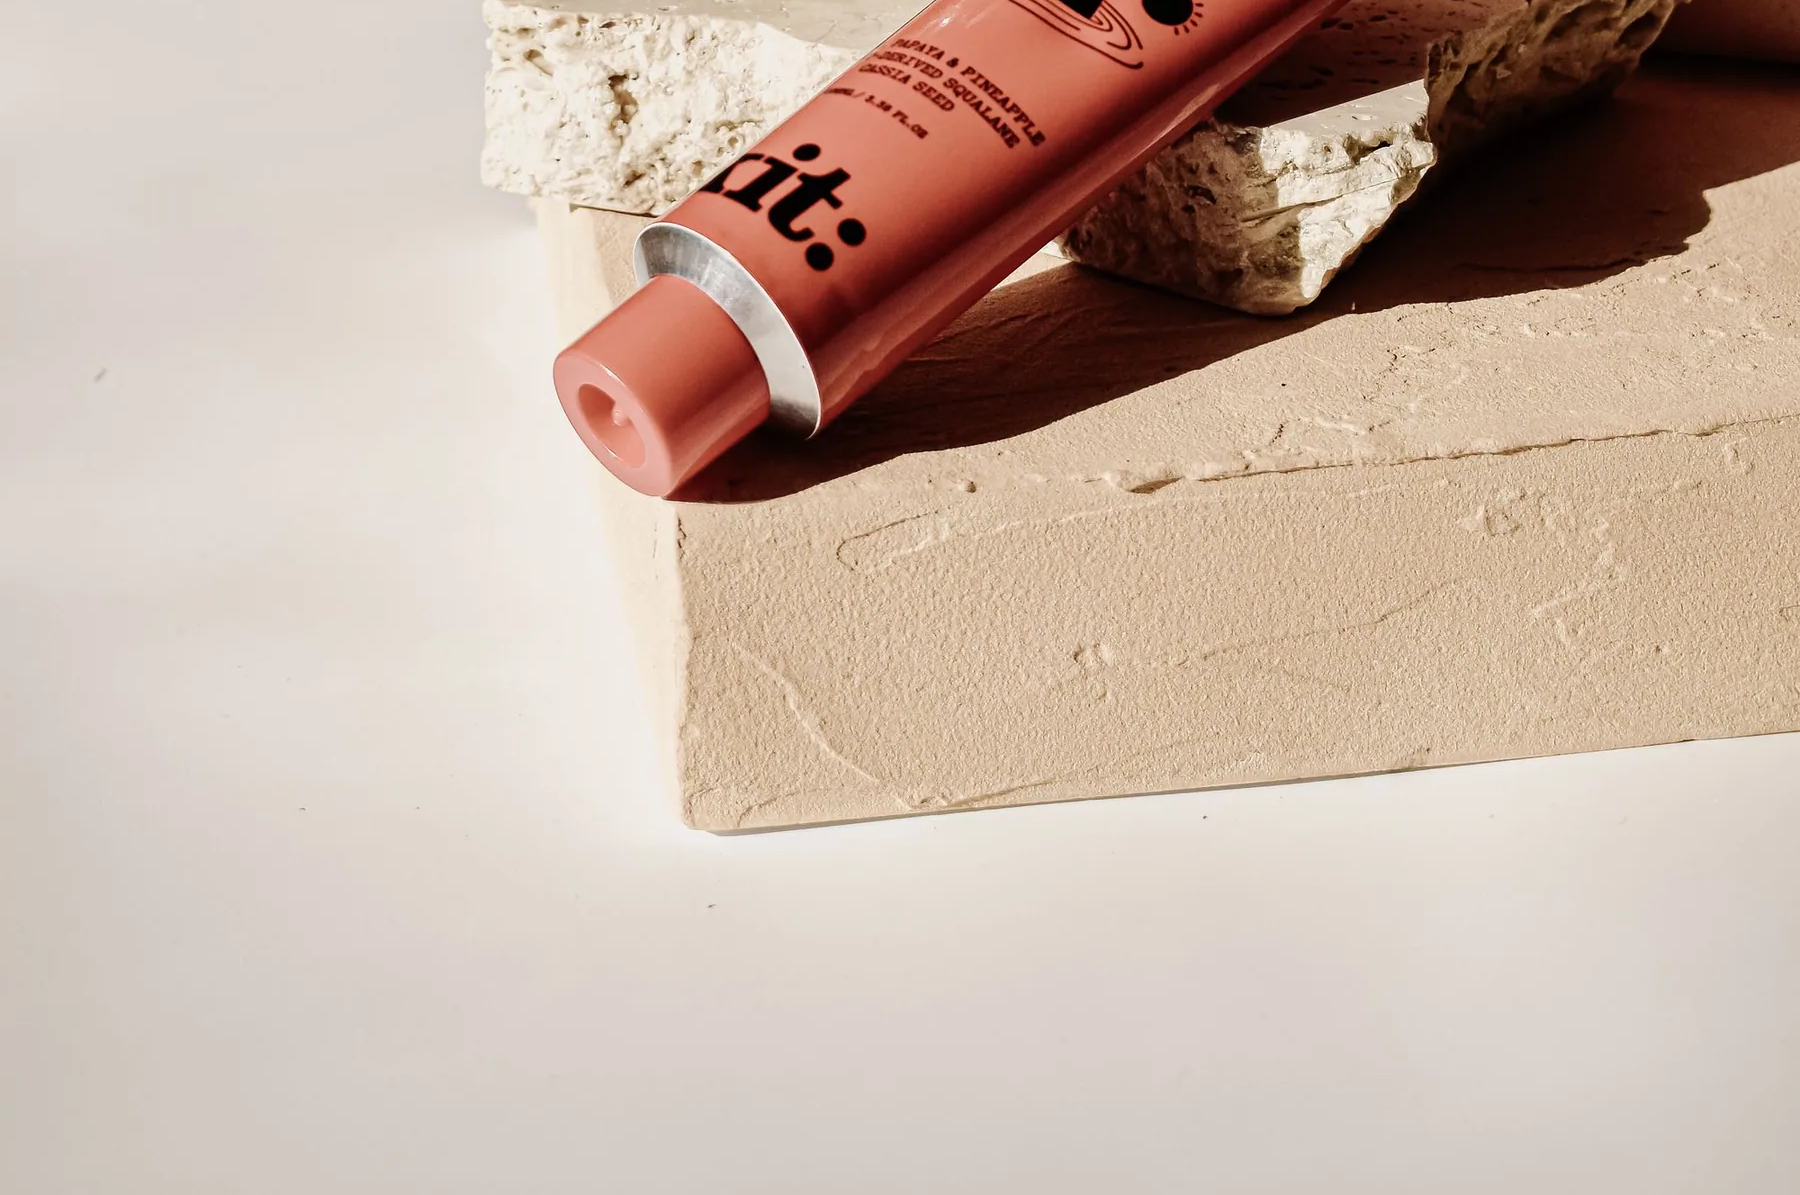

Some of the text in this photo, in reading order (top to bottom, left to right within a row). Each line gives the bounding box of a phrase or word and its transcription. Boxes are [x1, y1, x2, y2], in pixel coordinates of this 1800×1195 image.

[858, 63, 956, 112] CASSIA SEED
[891, 39, 945, 61] PAPAYA
[960, 66, 1047, 147] PINEAPPLE
[943, 76, 1021, 149] SQUALANE
